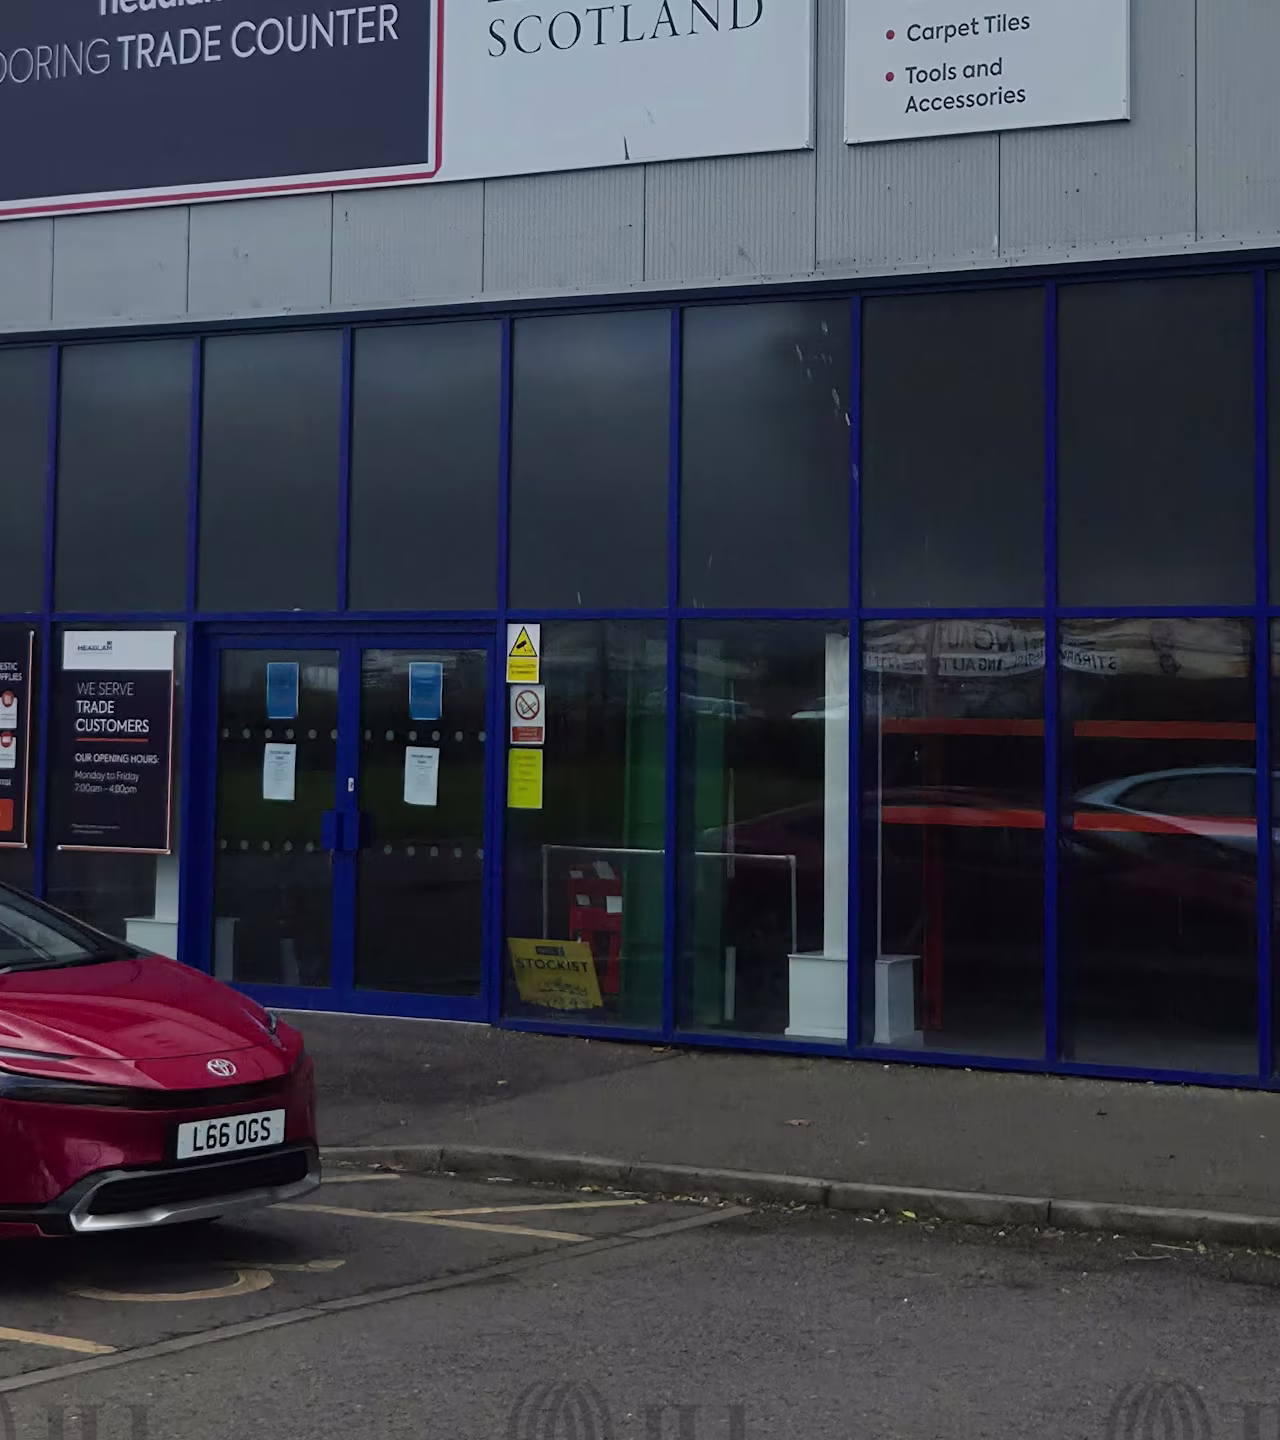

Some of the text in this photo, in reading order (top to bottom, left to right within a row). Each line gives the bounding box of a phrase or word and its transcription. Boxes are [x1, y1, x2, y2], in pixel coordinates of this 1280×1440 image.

[117, 25, 221, 71] TRADE
[231, 3, 399, 58] COUNTER
[487, 0, 763, 57] SCOTLAND
[907, 14, 1030, 43] Carpet Tiles
[905, 57, 1003, 84] Tools and
[905, 87, 1026, 113] Accessories
[77, 682, 135, 695] WE SERVE
[76, 700, 115, 713] TRADE
[75, 718, 149, 732] CUSTOMERS
[75, 753, 92, 763] OUR
[93, 753, 129, 763] OPENING
[74, 770, 140, 782] Monday to Friday
[515, 957, 588, 972] STOCKIST
[192, 1117, 271, 1151] L66 OGS
